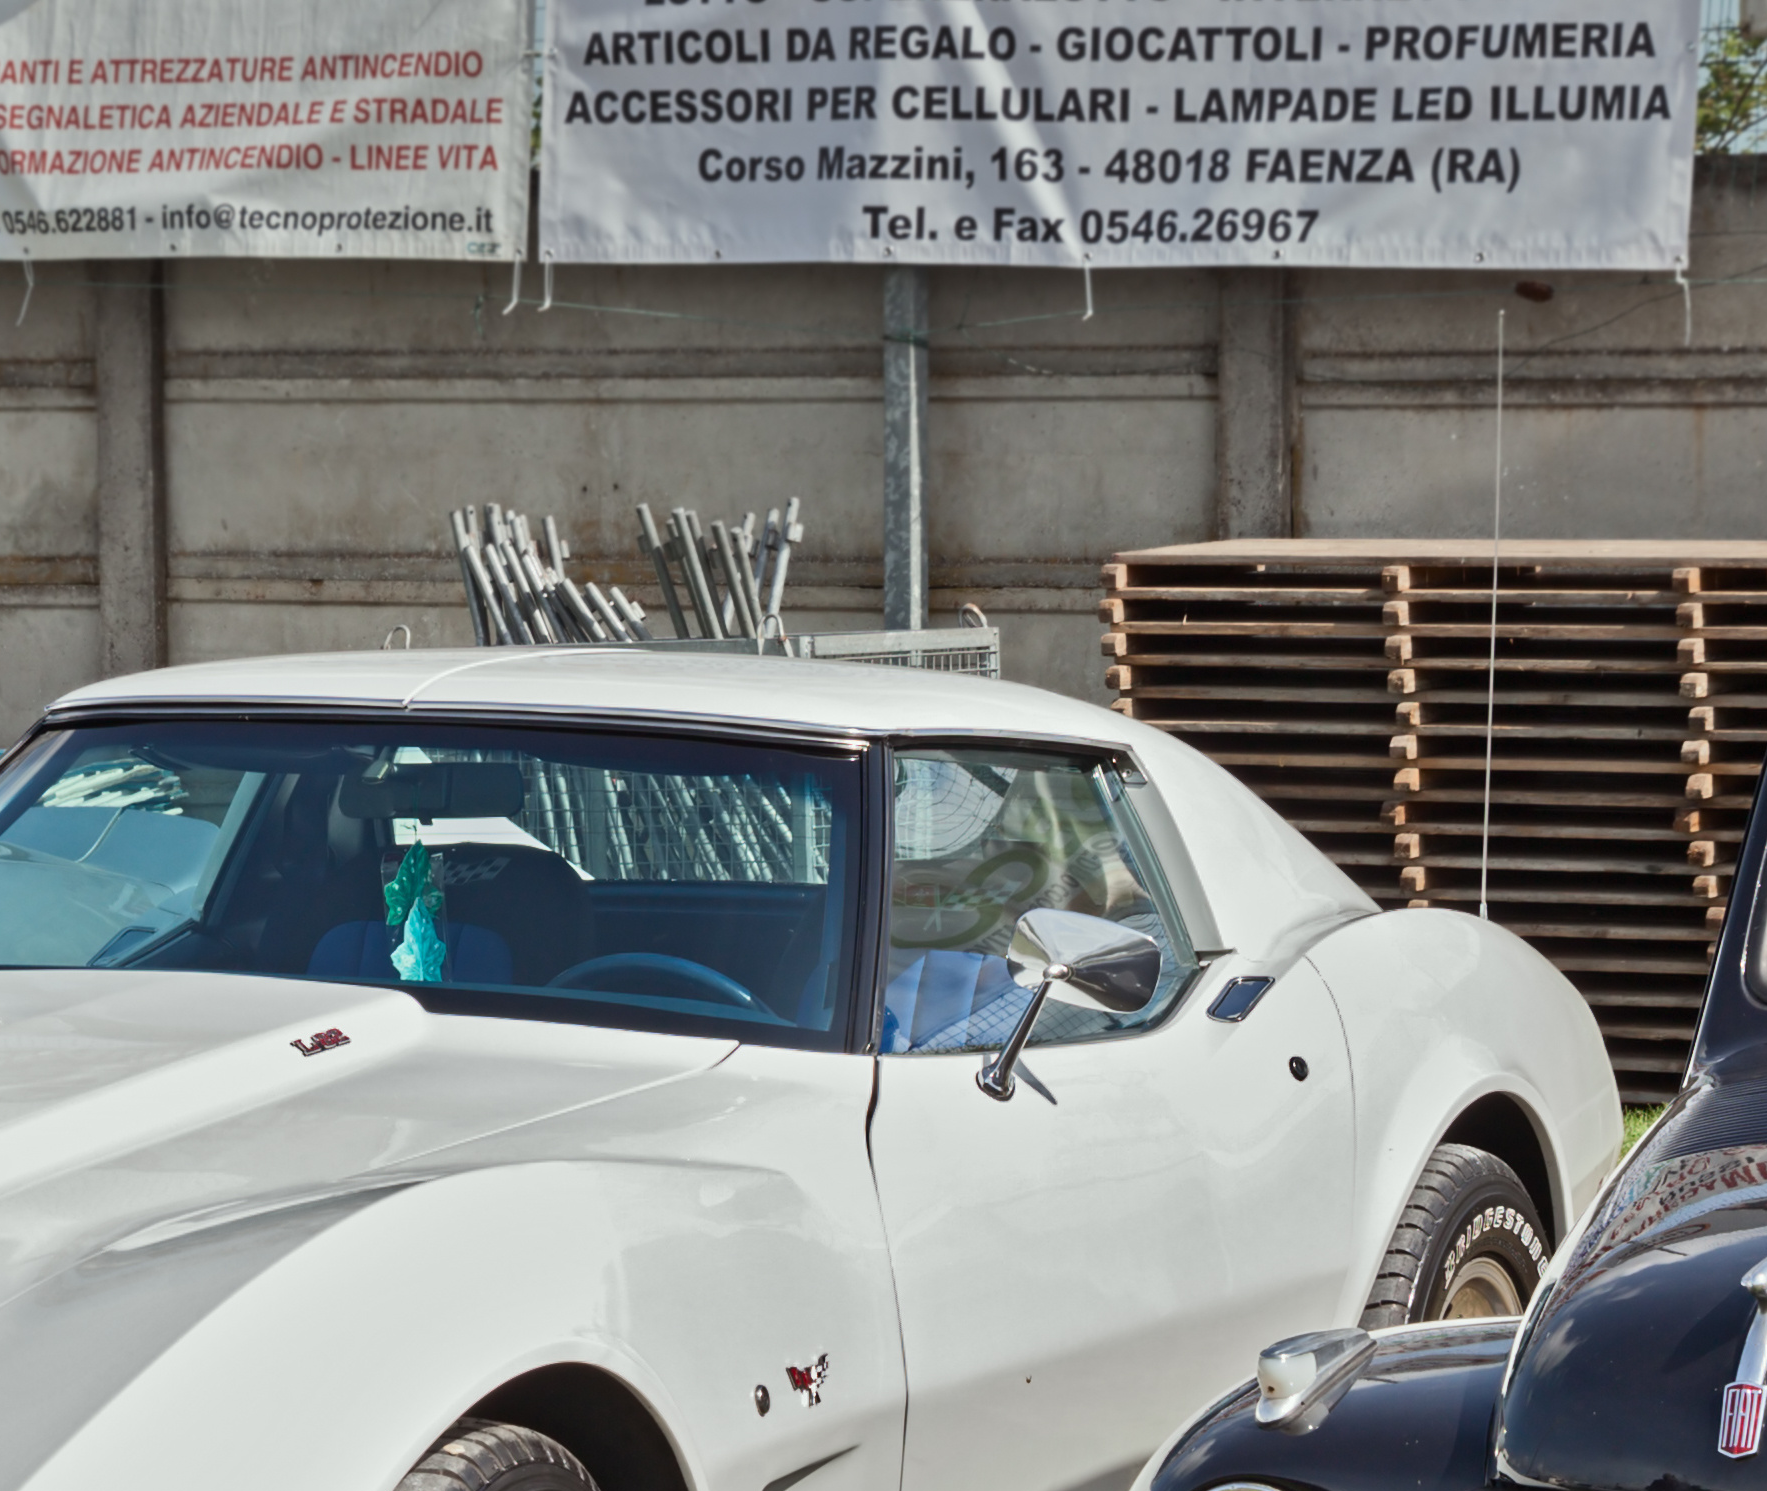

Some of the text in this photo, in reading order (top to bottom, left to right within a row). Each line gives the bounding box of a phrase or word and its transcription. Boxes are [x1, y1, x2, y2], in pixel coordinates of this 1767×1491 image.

[583, 28, 771, 66] ARTICOLI
[785, 27, 836, 63] DA
[848, 26, 1017, 62] REGALO
[1056, 26, 1323, 62] GIOCATTOLI
[1364, 22, 1657, 62] PROFUMERIA
[67, 59, 83, 85] E
[90, 56, 295, 85] ATTREZZATURE
[300, 50, 484, 82] ANTINCENDIO
[179, 101, 323, 129] AZIENDALE
[329, 99, 345, 125] E
[353, 97, 503, 125] STRADALE
[564, 88, 793, 125] ACCESSORI
[806, 86, 878, 122] PER
[891, 86, 1131, 124] CELLULARI
[1173, 87, 1378, 123] LAMPADE
[1391, 85, 1474, 122] LED
[1490, 84, 1672, 122] ILLUMIA
[147, 143, 324, 174] ANTINCENDIO
[350, 145, 429, 171] LINEE
[436, 144, 499, 171] VITA
[697, 147, 806, 184] Corso
[816, 146, 976, 190] Mazzini,
[990, 147, 1066, 184] 163
[1104, 147, 1232, 185] 48018
[1244, 147, 1416, 185] FAENZA
[1431, 147, 1522, 194] (RA)
[161, 204, 495, 236] info@tecnoprotezione.it
[862, 205, 1320, 245] Tel. e Fax 0546.26967
[1721, 1388, 1763, 1448] FIAT
